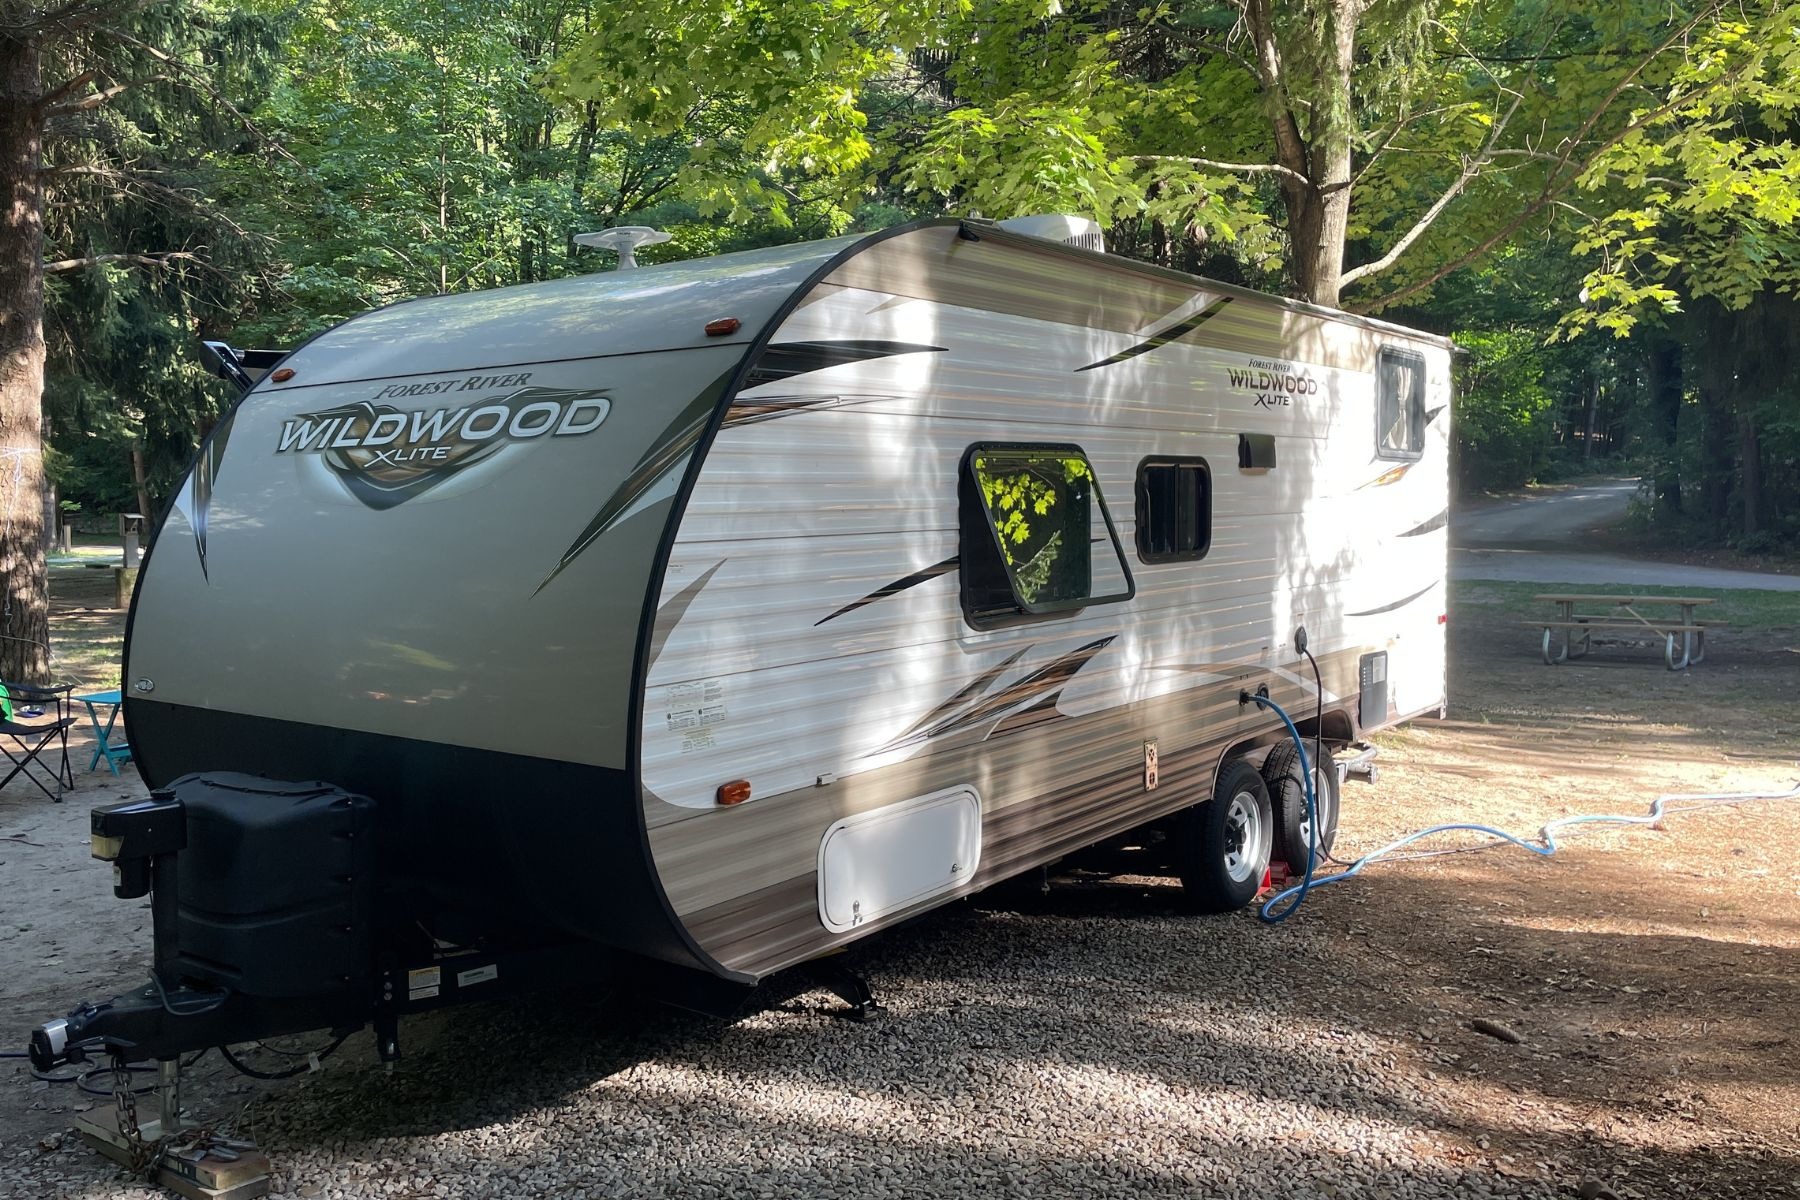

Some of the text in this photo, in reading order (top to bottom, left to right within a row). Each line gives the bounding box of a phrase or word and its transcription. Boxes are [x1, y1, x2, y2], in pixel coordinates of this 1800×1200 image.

[1248, 359, 1291, 373] FOREST RIVER
[372, 372, 533, 400] FOREST RIVER
[1227, 368, 1318, 395] WILDWOOD
[278, 397, 613, 452] WILDWOOD
